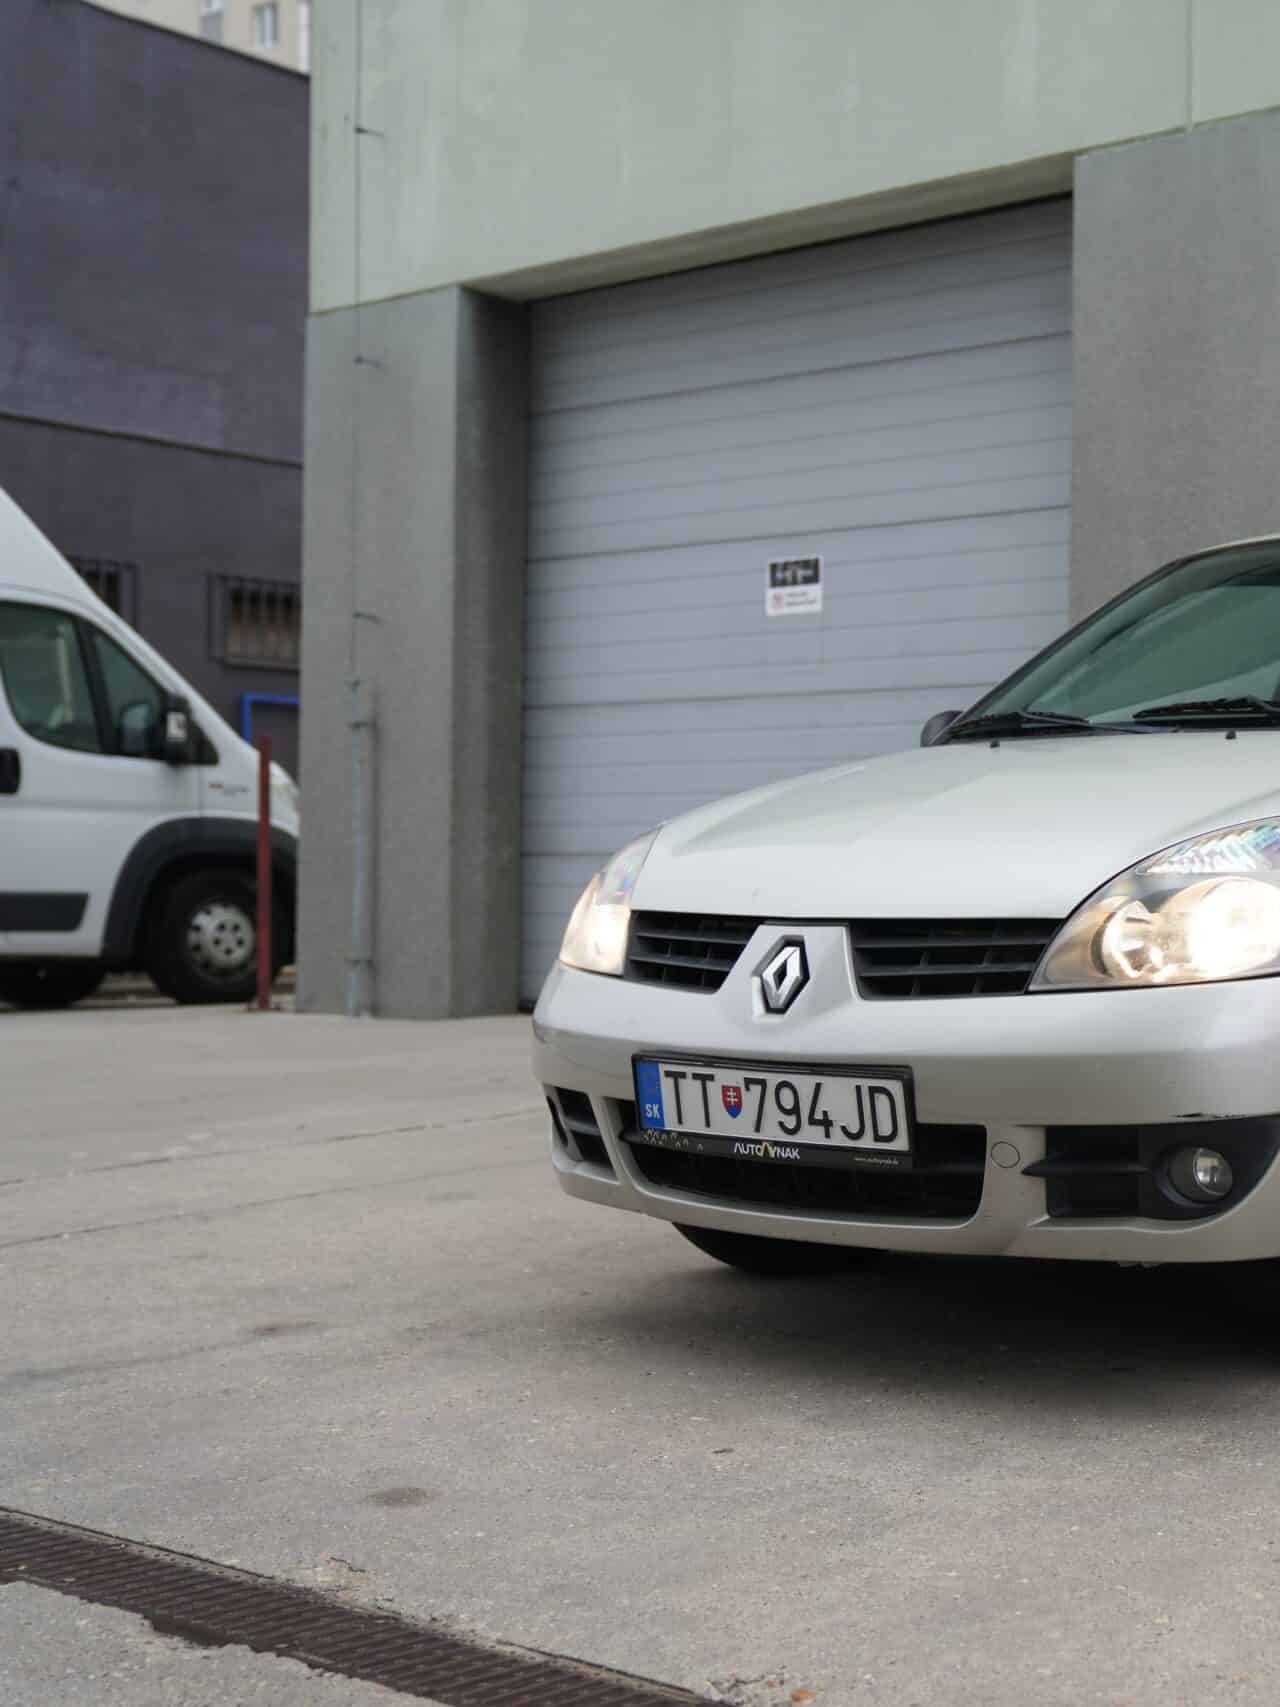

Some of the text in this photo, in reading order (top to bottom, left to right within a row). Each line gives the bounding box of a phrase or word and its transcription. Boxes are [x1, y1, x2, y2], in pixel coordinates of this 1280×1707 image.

[645, 1103, 661, 1120] SK
[664, 1070, 899, 1144] TT 794JD
